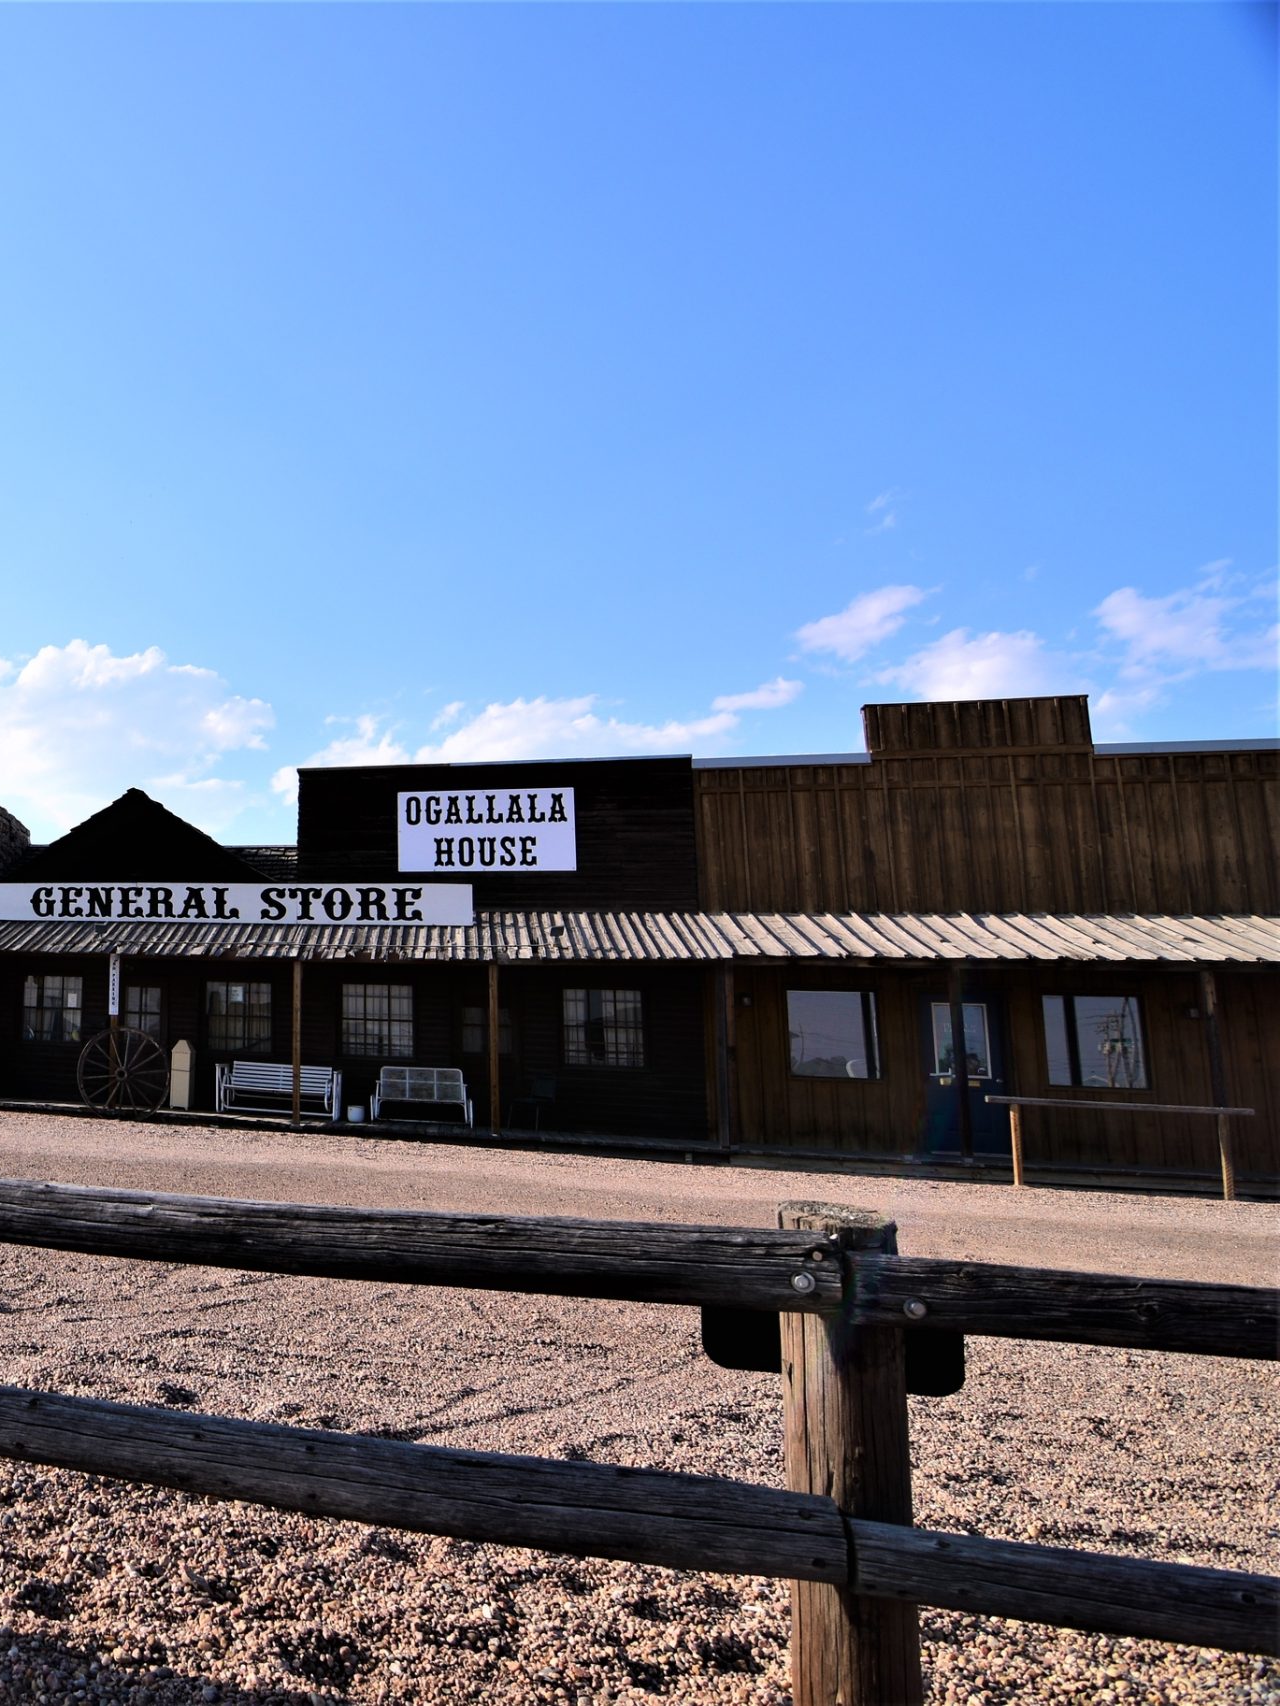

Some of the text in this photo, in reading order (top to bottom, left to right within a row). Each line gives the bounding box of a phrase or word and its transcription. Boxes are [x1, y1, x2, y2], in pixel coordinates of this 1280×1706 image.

[405, 793, 568, 825] OGALLALA
[434, 836, 538, 867] HOUSE
[29, 886, 424, 922] GENERAL STORE
